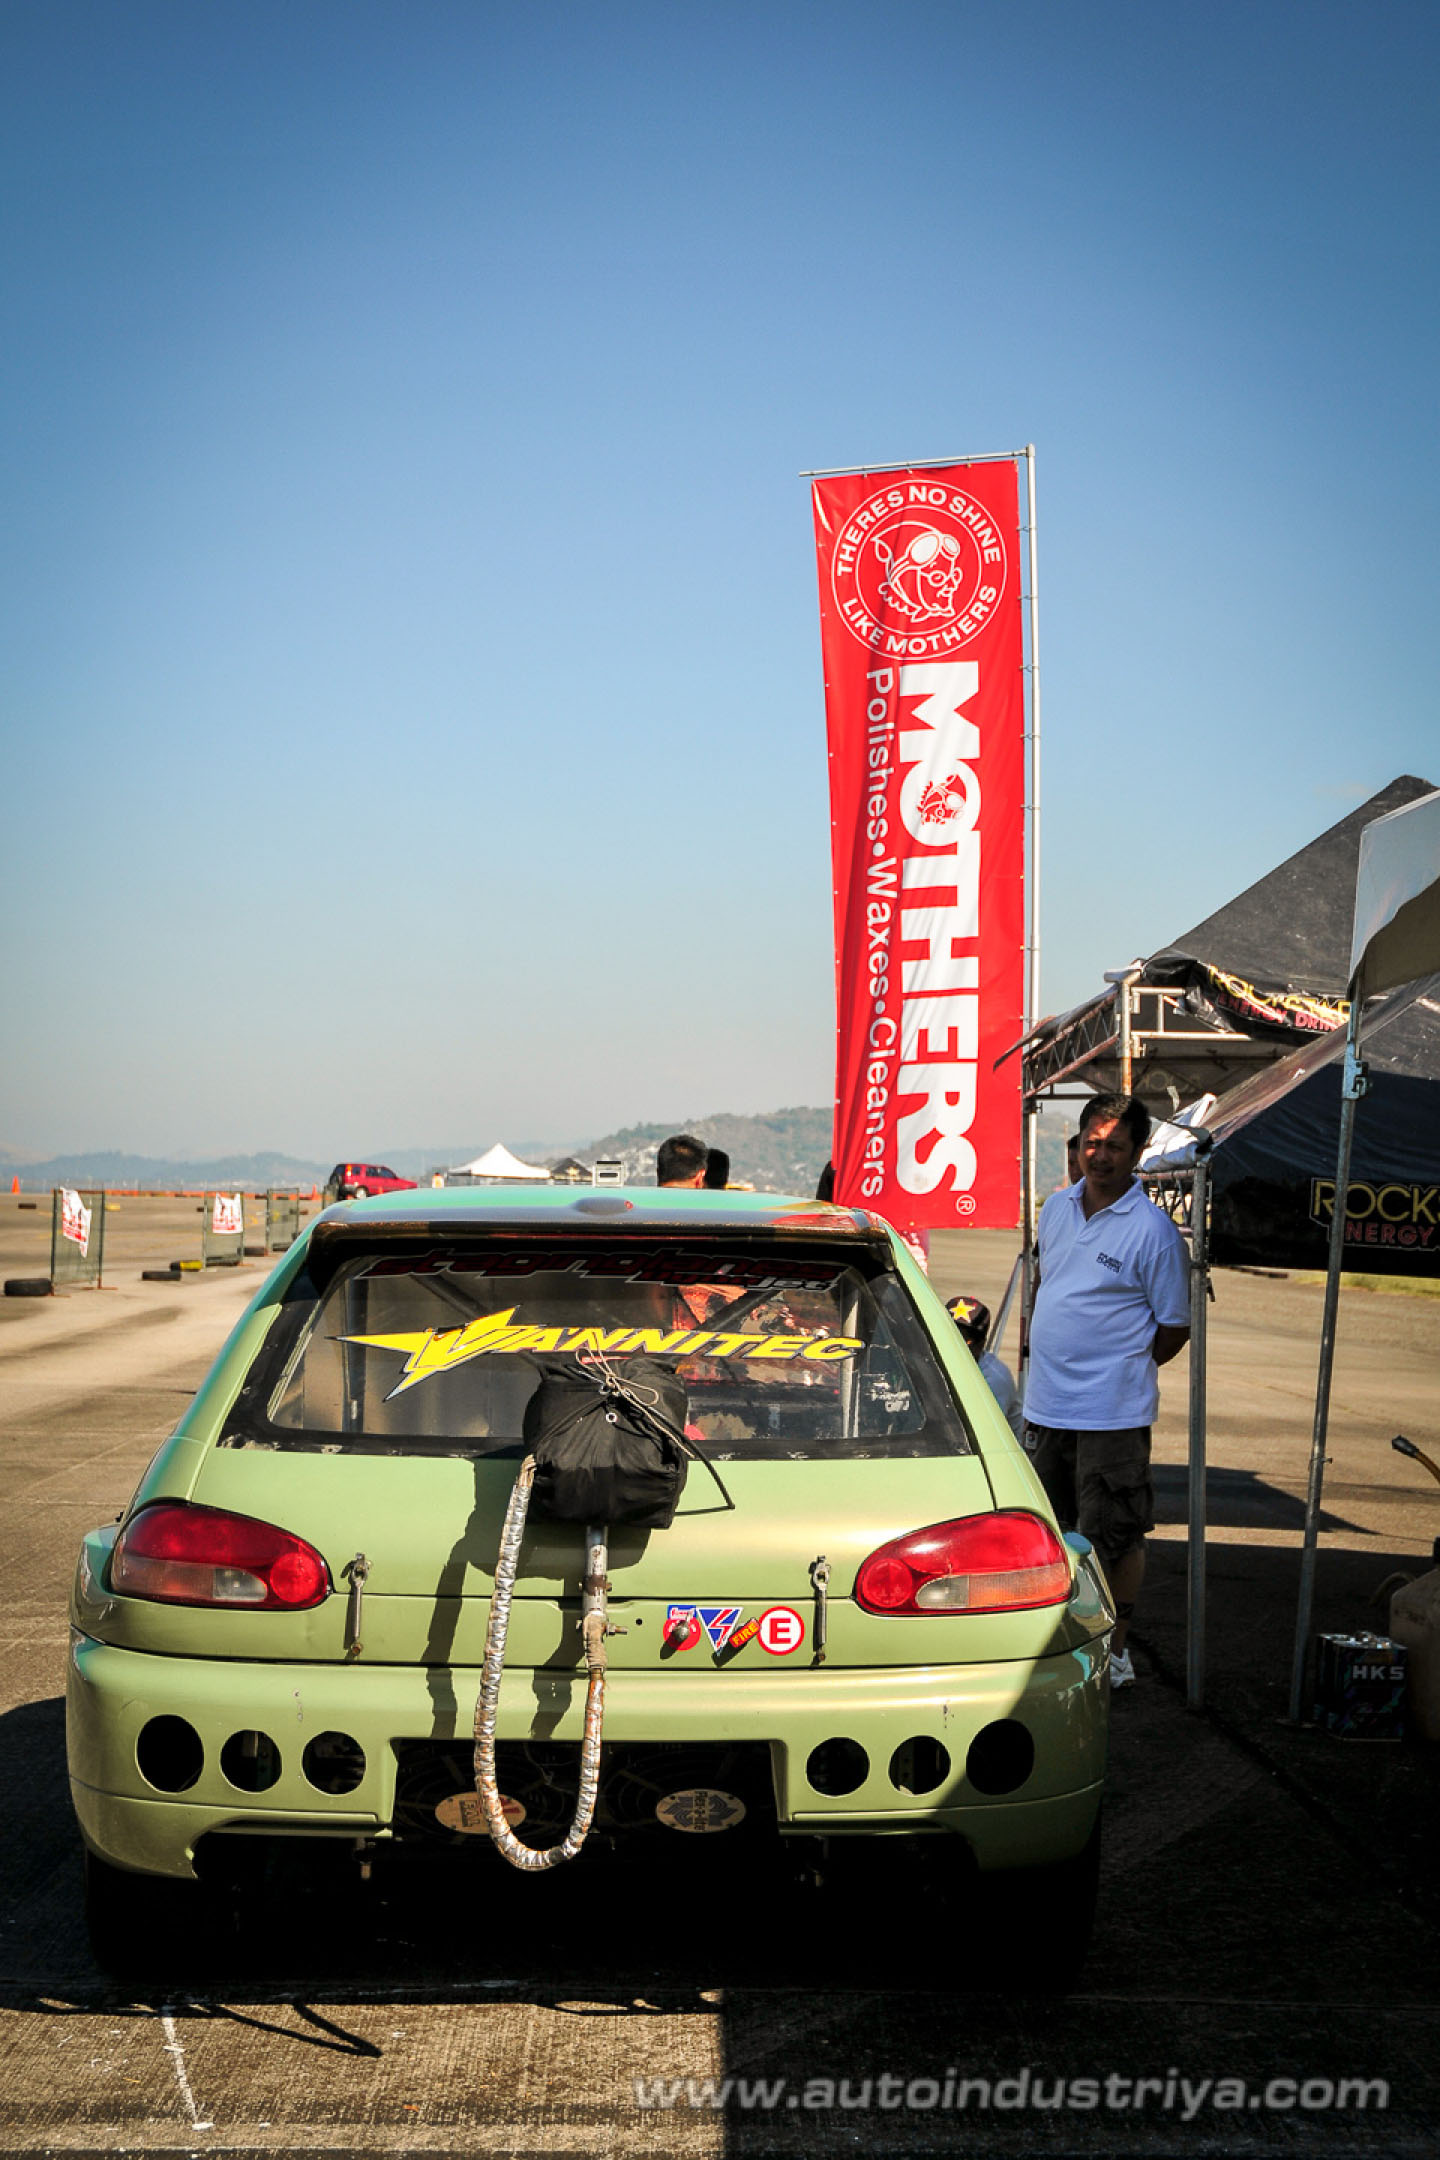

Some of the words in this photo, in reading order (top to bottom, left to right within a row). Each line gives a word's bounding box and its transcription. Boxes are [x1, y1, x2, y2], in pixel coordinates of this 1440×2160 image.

[837, 490, 904, 577] THERES
[908, 485, 947, 505] NO
[949, 495, 1001, 565] SHINE
[842, 598, 884, 646] LIKE
[886, 585, 997, 655] MOTHERS
[896, 660, 981, 1195] MOTHERS
[1313, 1181, 1440, 1224] ROCK
[731, 1621, 760, 1647] FIRE
[769, 1617, 792, 1645] E
[1352, 1664, 1405, 1681] HKS
